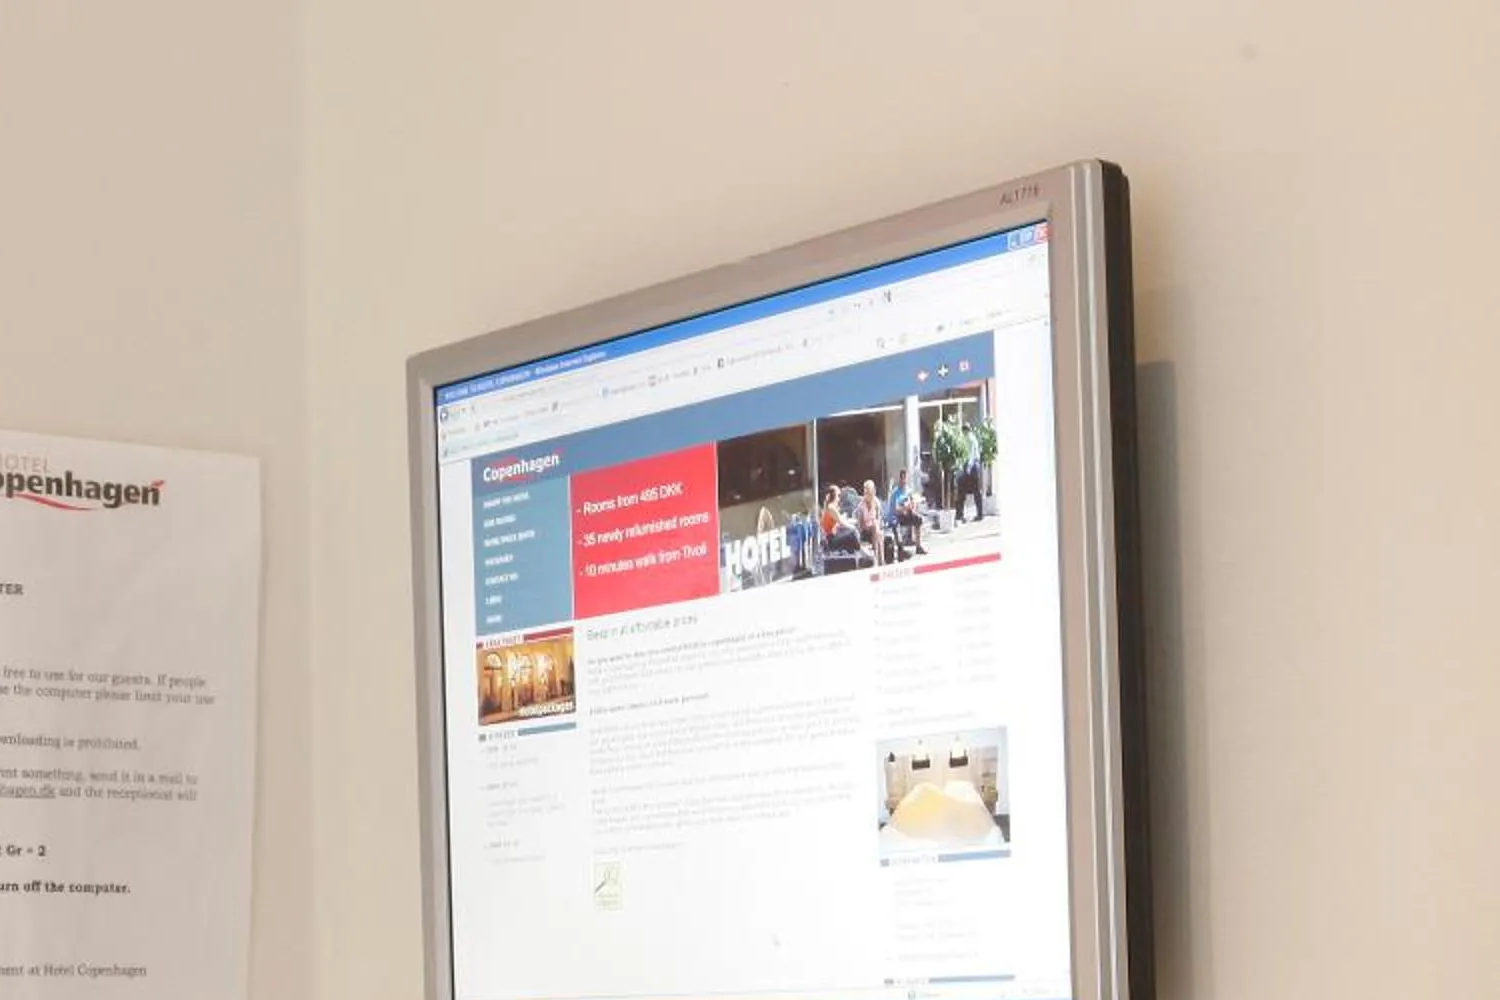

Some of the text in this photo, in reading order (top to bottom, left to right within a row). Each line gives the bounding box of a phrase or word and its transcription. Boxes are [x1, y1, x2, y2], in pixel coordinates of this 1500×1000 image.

[483, 453, 561, 482] Copenhagen
[583, 499, 616, 515] Rooms
[725, 525, 792, 577] HOTEL
[3, 665, 26, 679] free
[29, 668, 41, 680] to
[45, 671, 64, 681] use
[68, 670, 83, 682] for
[87, 673, 109, 683] our
[157, 674, 167, 686] If
[168, 676, 206, 690] people
[13, 683, 33, 696] the
[36, 687, 92, 702] computer
[94, 687, 131, 702] please
[165, 693, 191, 705] your
[63, 736, 75, 747] is
[90, 769, 117, 782] send
[121, 769, 130, 782] it
[133, 770, 145, 783] in
[158, 771, 183, 784] mail
[186, 773, 199, 785] to
[60, 785, 81, 797] and
[84, 785, 102, 798] the
[177, 788, 198, 801] will
[5, 843, 22, 857] Gr
[37, 844, 47, 857] 2
[23, 879, 42, 893] off
[45, 880, 65, 894] the
[68, 882, 131, 897] computer.
[28, 965, 41, 977] at
[43, 963, 75, 977] Hotel
[77, 963, 147, 979] Copenhagen
